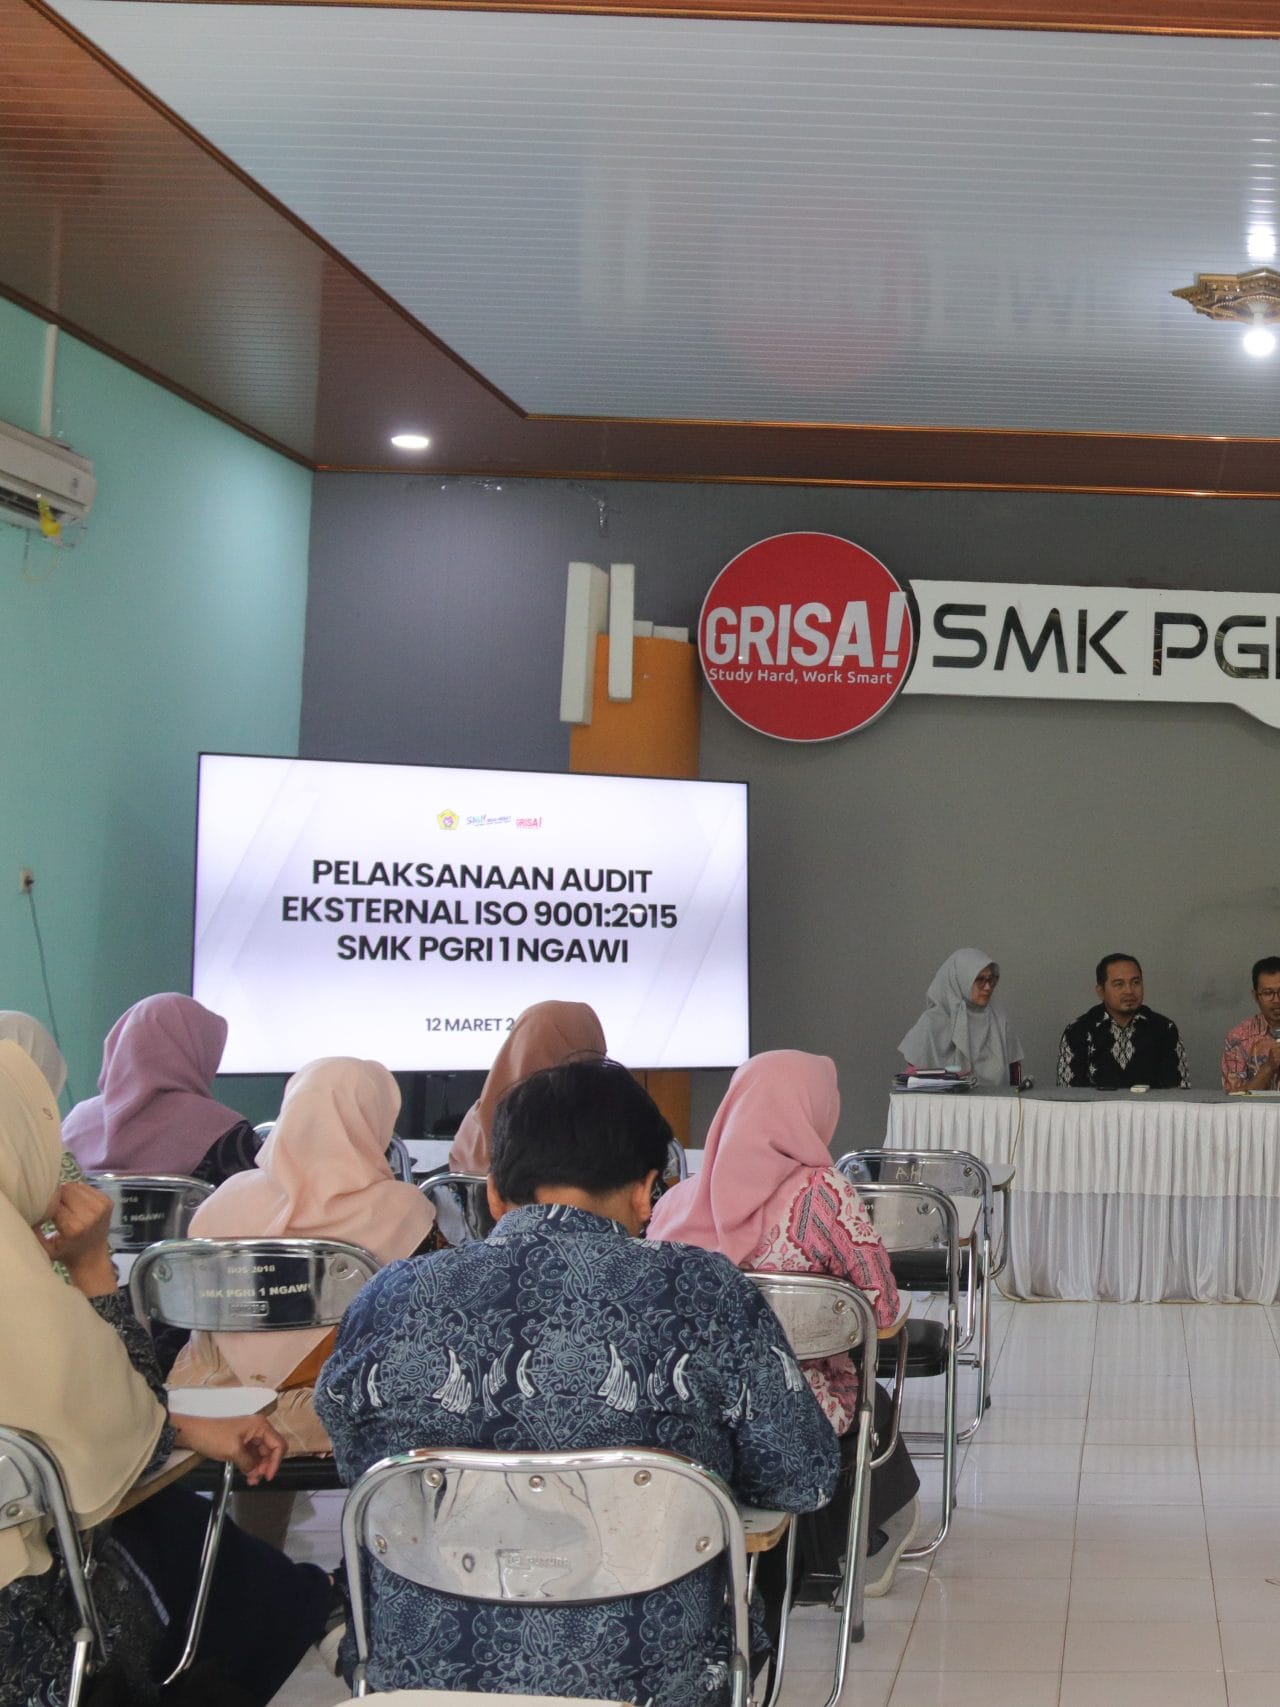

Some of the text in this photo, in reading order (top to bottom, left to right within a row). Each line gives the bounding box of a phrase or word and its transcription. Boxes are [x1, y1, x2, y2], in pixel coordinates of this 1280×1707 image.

[705, 591, 907, 668] GRISA!
[932, 603, 1129, 675] SMK
[707, 667, 893, 685] Study Hard, Work Smart
[312, 858, 653, 893] PELAKSANAAN AUDIT
[281, 896, 678, 929] EKSTERNAL ISO 9001:2015
[337, 933, 628, 964] SMK PGRI 1 NGAWI
[425, 1017, 441, 1032] 12
[445, 1018, 502, 1032] MARET
[258, 1287, 266, 1297] 1
